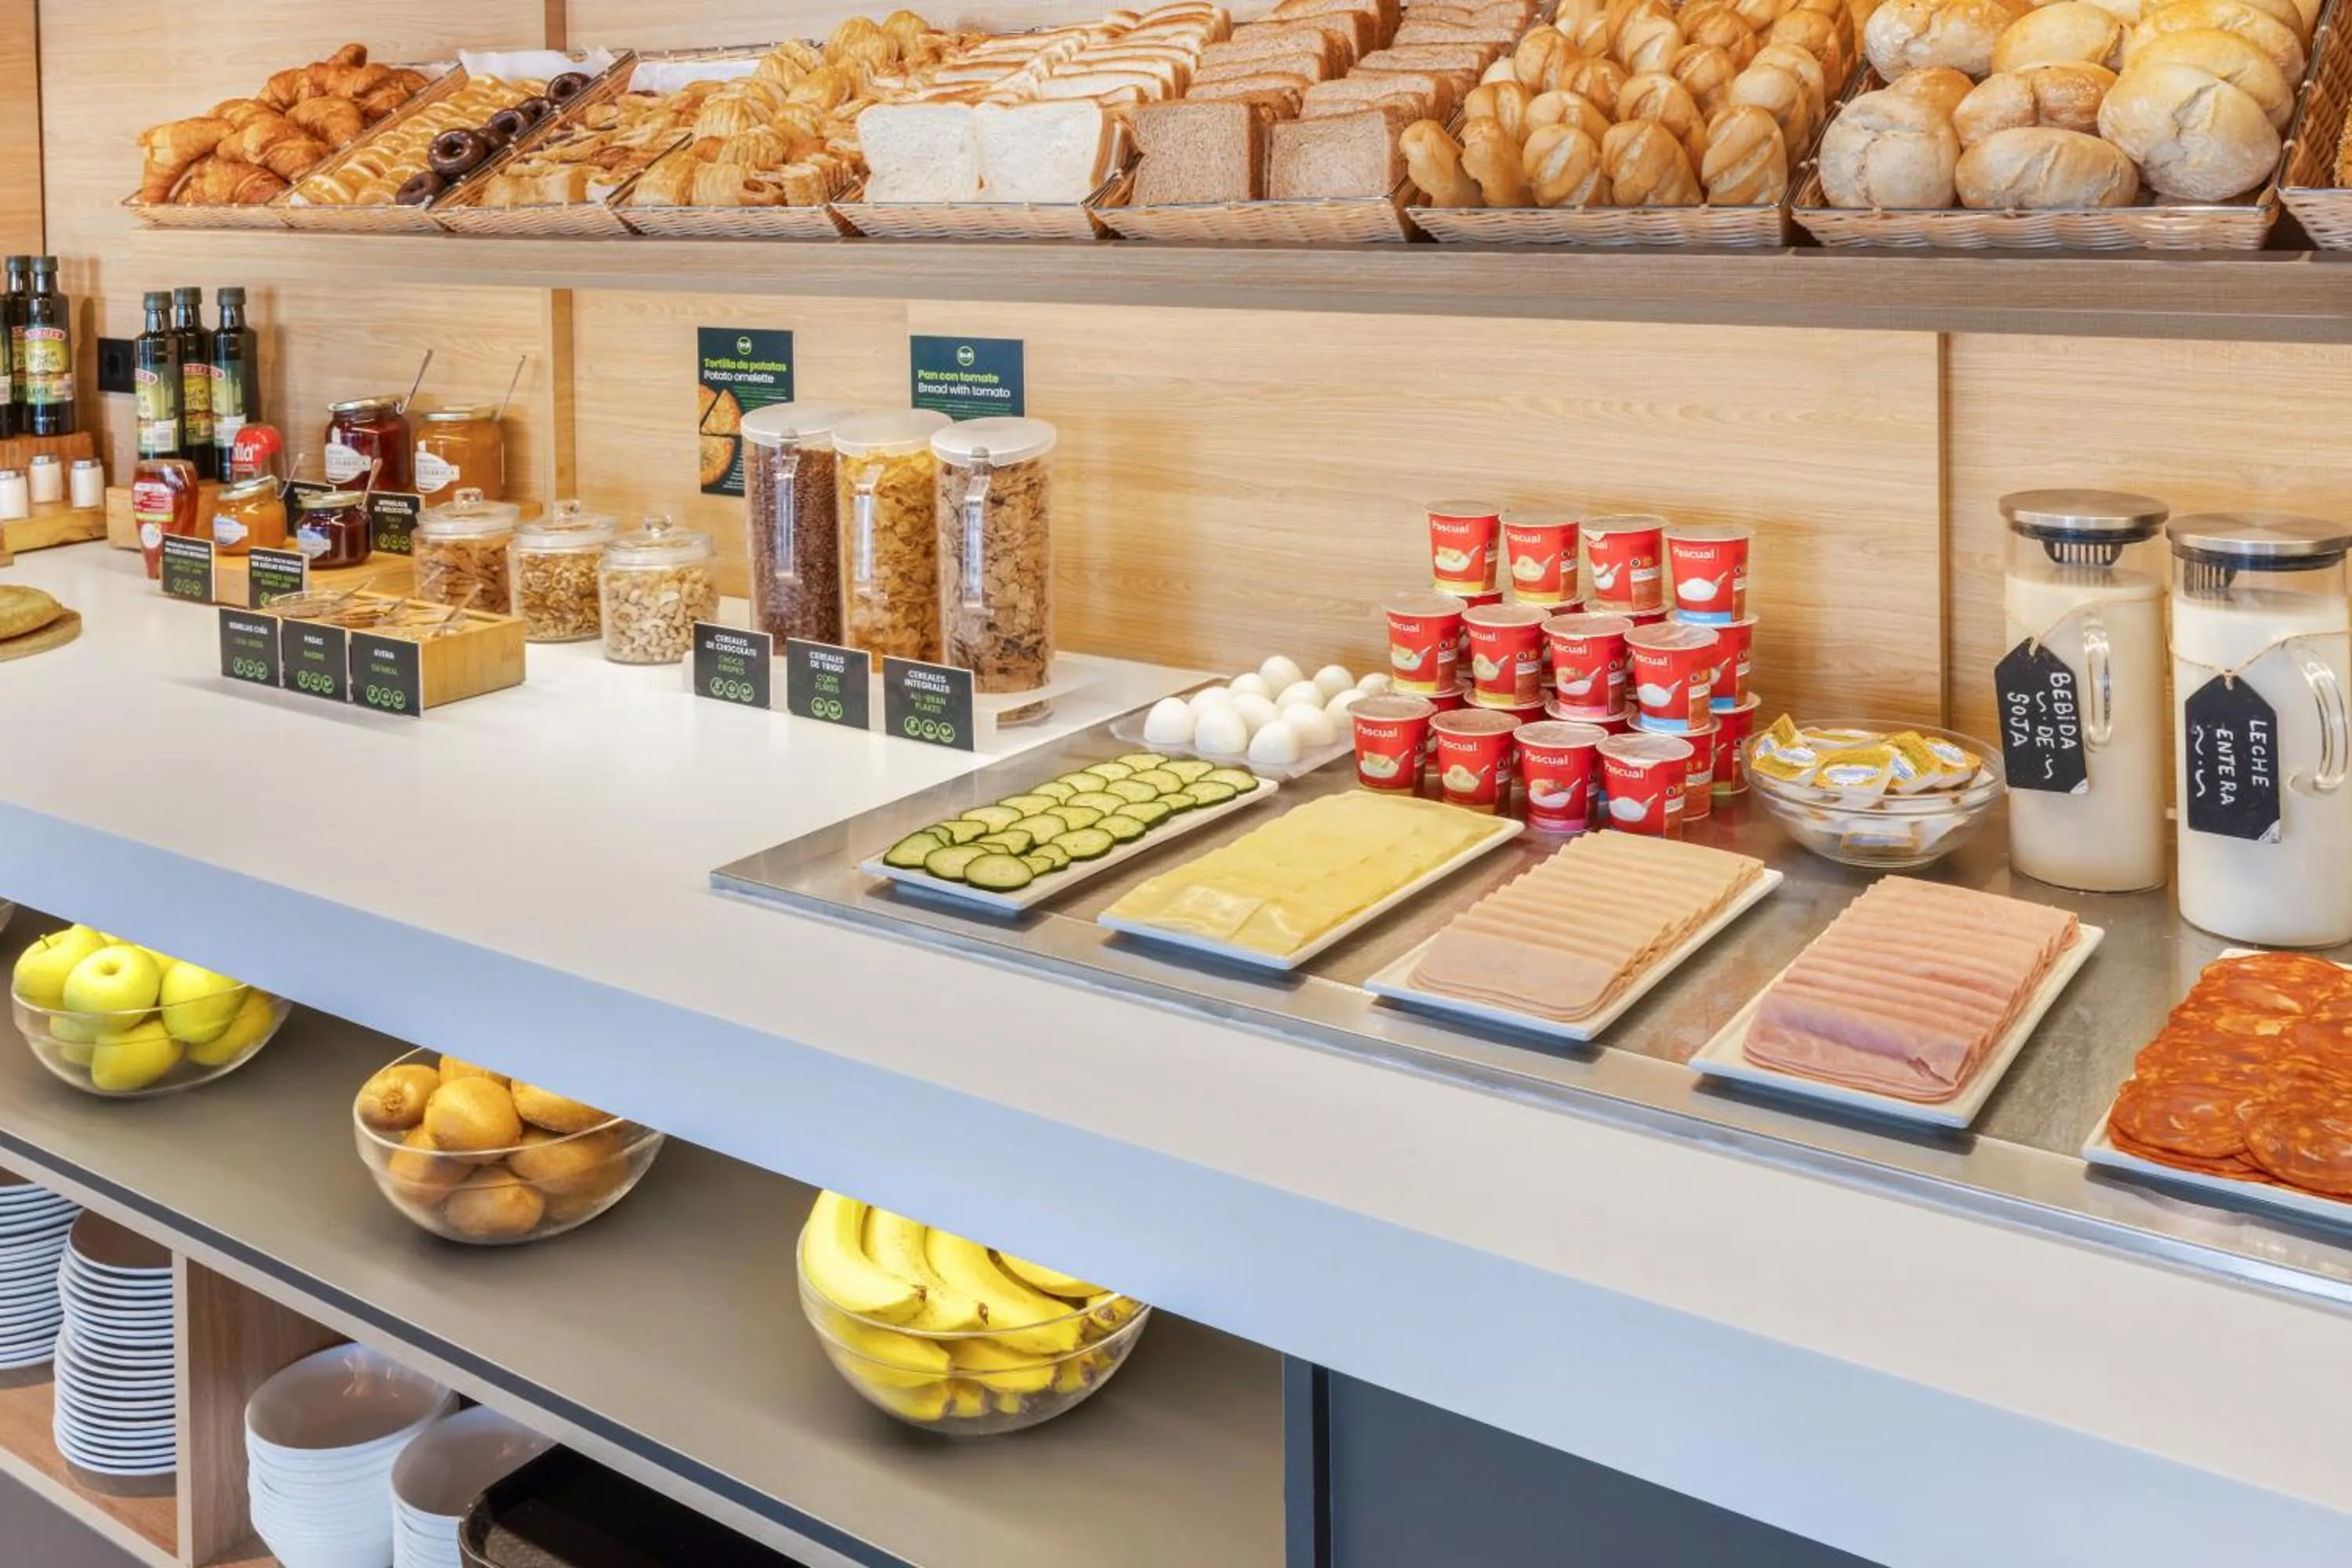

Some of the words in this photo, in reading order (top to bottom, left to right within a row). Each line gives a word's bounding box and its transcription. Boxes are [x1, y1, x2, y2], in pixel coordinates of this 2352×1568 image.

[704, 358, 736, 369] Tortilla
[737, 360, 749, 369] de
[704, 369, 733, 381] Potato
[734, 372, 775, 383] omelette
[918, 369, 938, 380] Pan
[939, 372, 959, 381] con
[960, 372, 1000, 383] tomate
[918, 382, 948, 394] Bread
[949, 383, 971, 395] with
[972, 387, 1011, 397] tomato
[1432, 520, 1469, 534] Pascual
[1673, 545, 1715, 560] Pascual
[714, 634, 748, 646] CEREALES
[716, 643, 757, 658] CHOCOLATE
[810, 652, 844, 664] CEREALES
[810, 660, 819, 669] DE
[822, 661, 844, 673] TRIGO
[908, 670, 946, 684] CEREALES
[904, 678, 950, 693] INTEGRALES
[2007, 691, 2031, 747] SOJA
[1356, 723, 1398, 738] Pascual
[2035, 725, 2055, 749] DE
[1438, 736, 1477, 752] Pascual
[1525, 750, 1569, 765] Pascual
[2249, 720, 2270, 788] LECHE
[1605, 762, 1644, 779] Pascual
[2216, 728, 2238, 805] ENTERA
